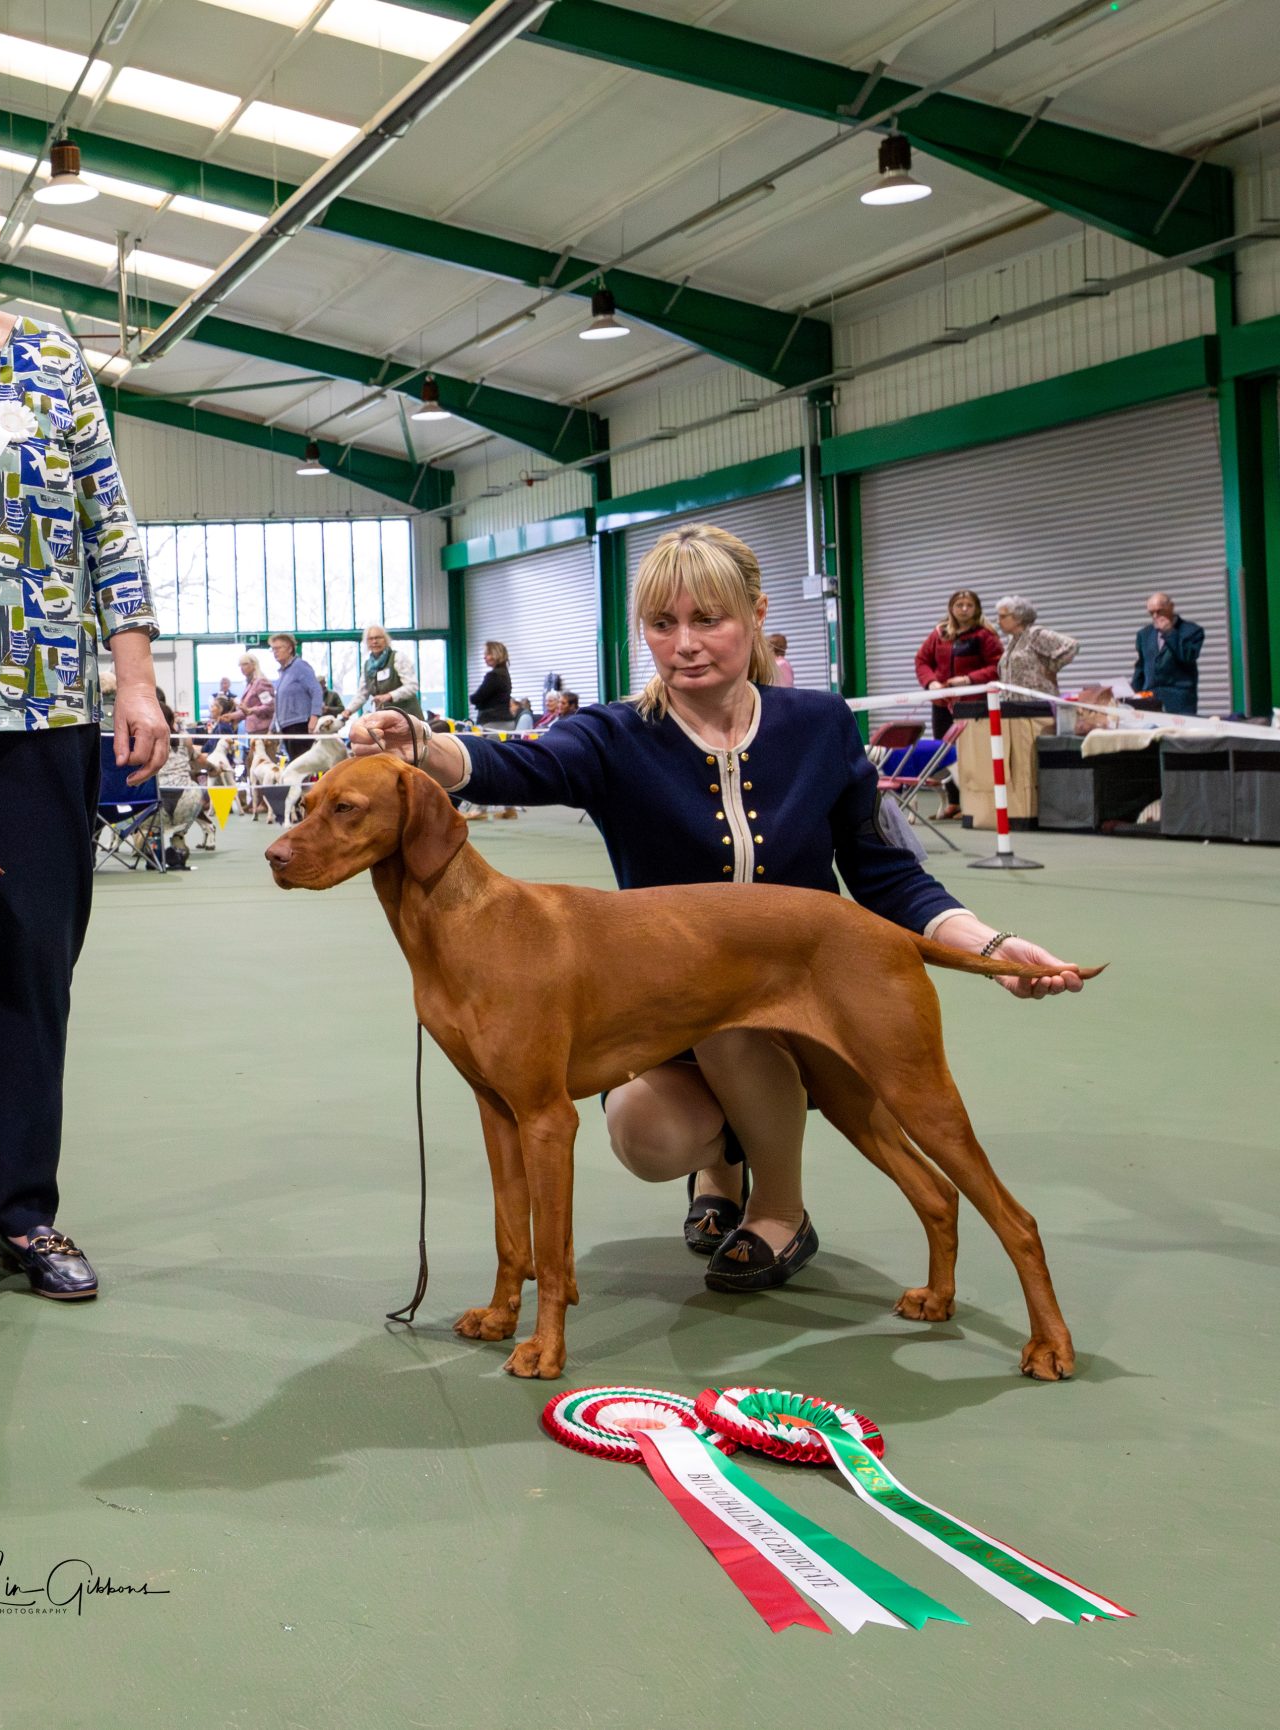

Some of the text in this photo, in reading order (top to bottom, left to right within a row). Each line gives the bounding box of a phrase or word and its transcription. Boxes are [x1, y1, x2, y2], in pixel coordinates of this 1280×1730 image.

[688, 1473, 839, 1588] BITCH CHALLENGE CERTIFICATE
